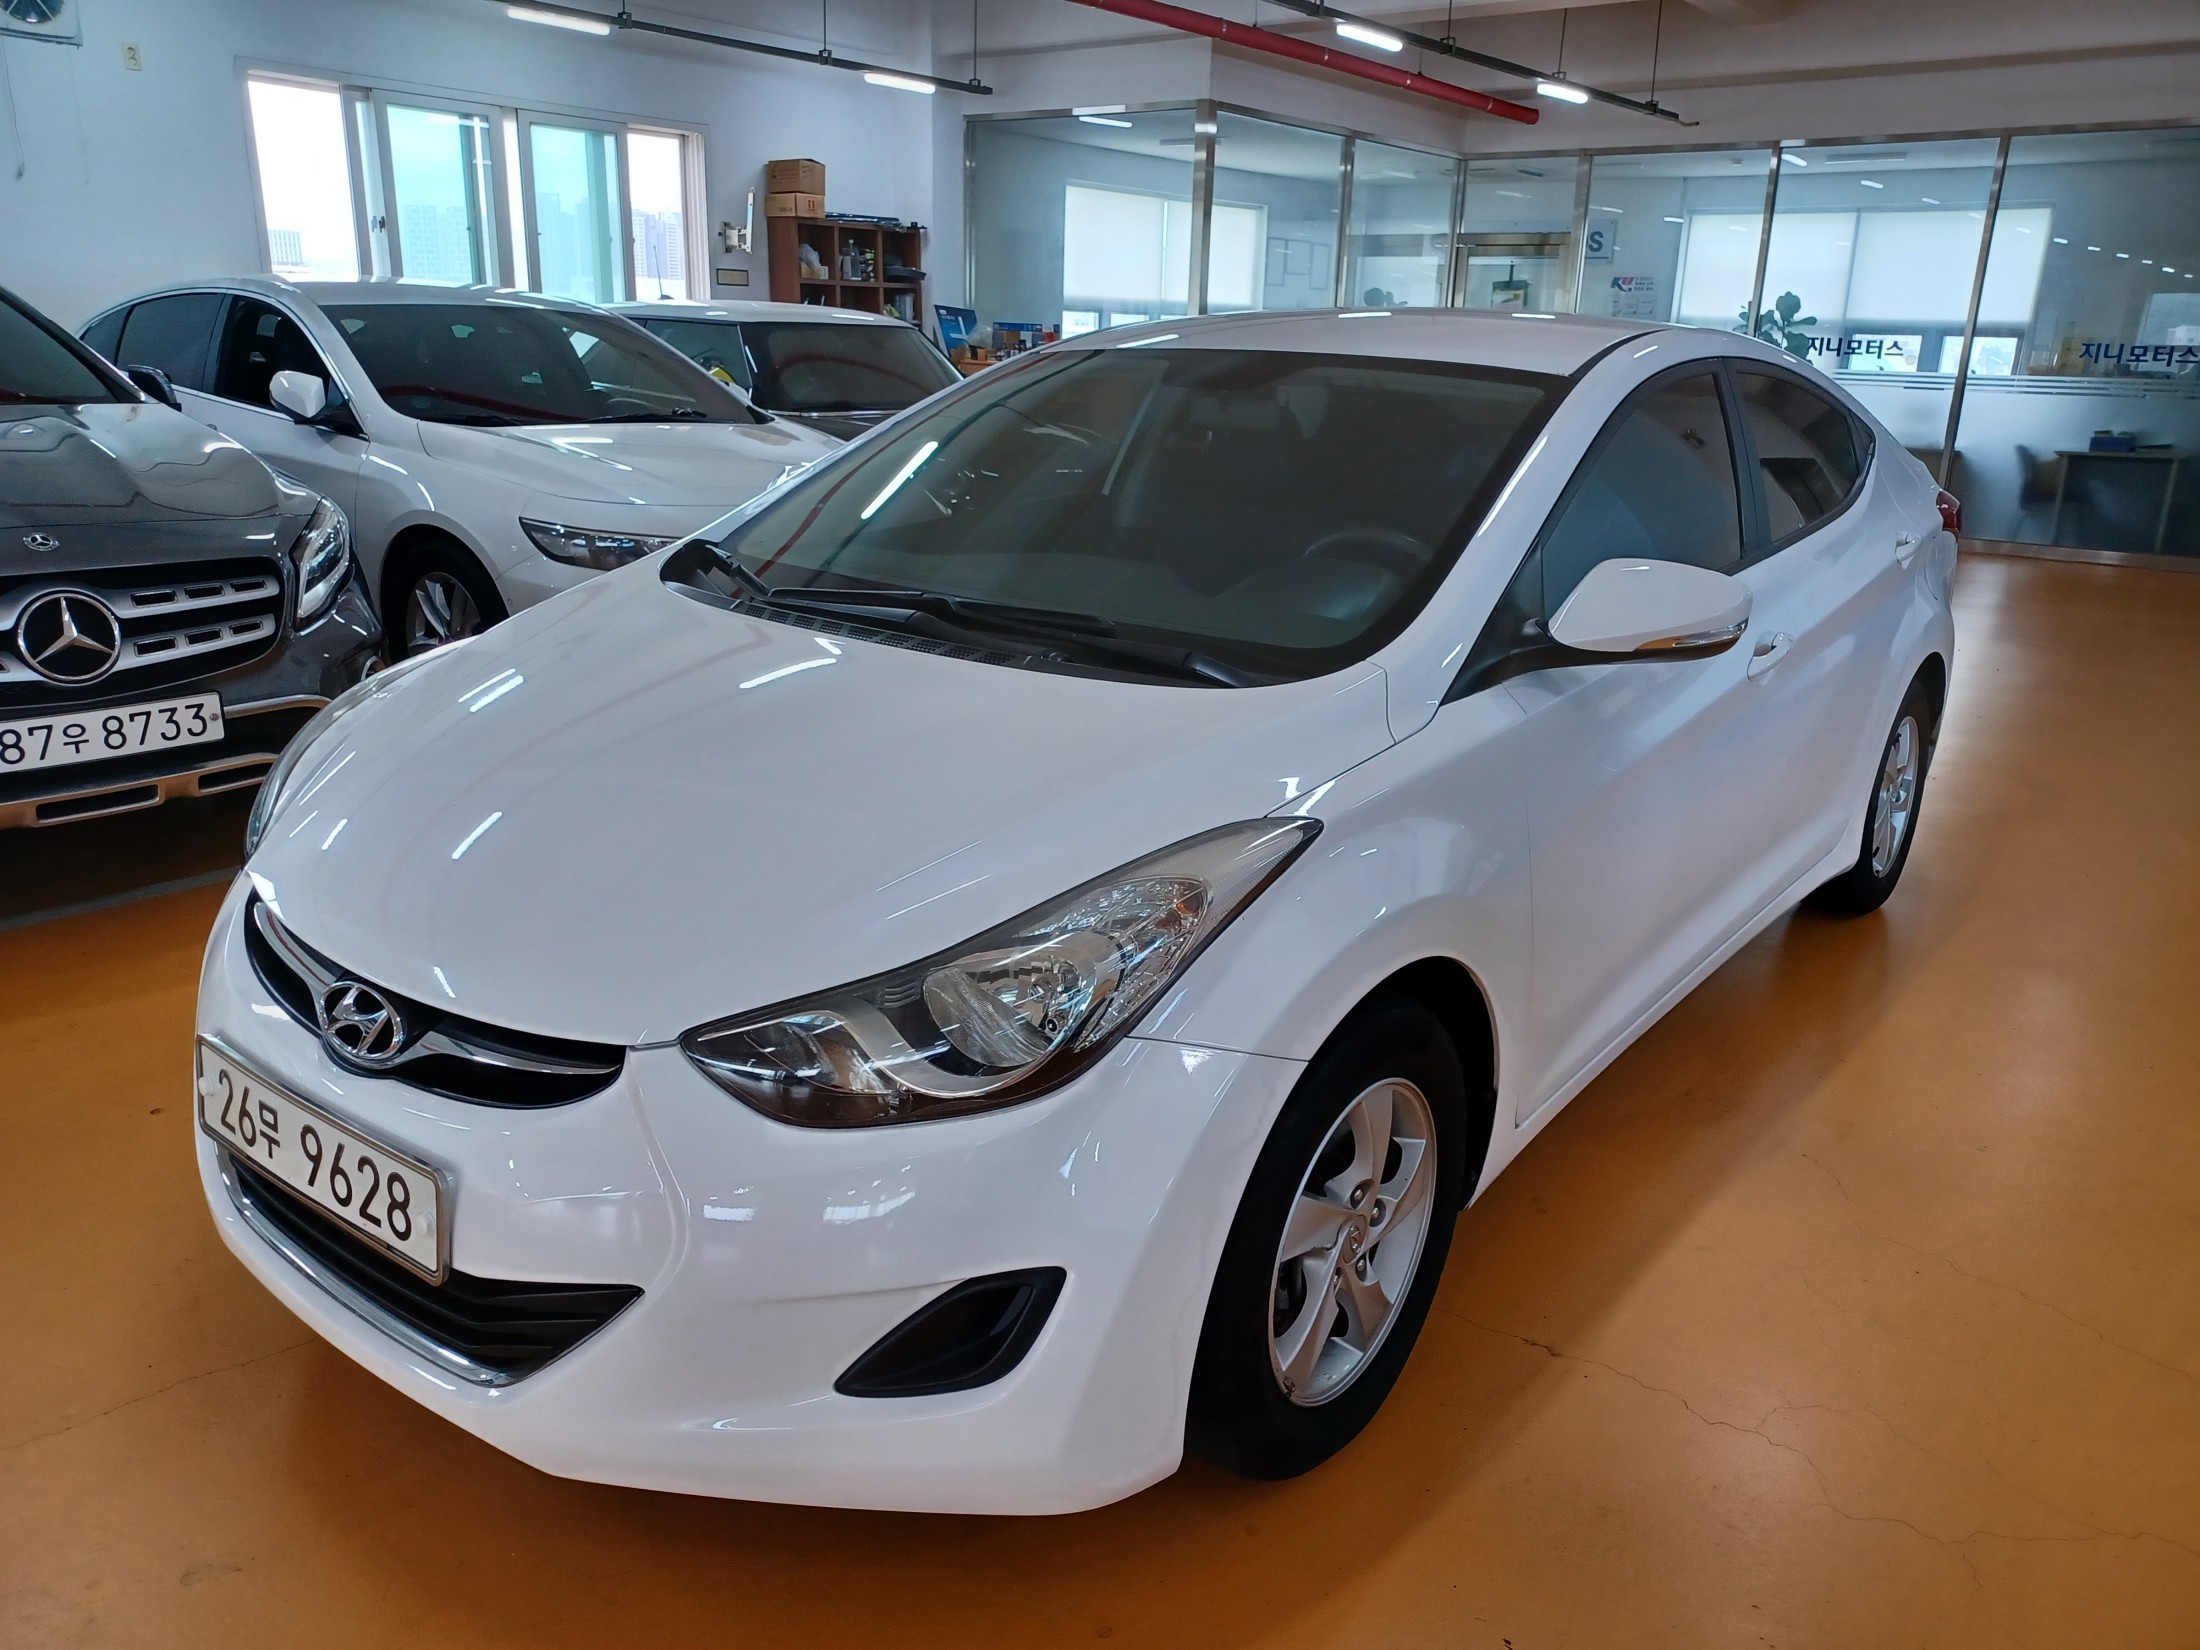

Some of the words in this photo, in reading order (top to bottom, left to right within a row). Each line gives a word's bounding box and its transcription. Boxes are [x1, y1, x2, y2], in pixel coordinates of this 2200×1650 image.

[1586, 231, 1604, 252] S
[1807, 337, 1903, 359] 지니모터스
[2078, 342, 2200, 367] 지니모터스
[0, 723, 90, 765] 87우
[102, 702, 208, 750] 8733
[218, 1068, 281, 1160] 26무
[300, 1123, 413, 1242] 9628
